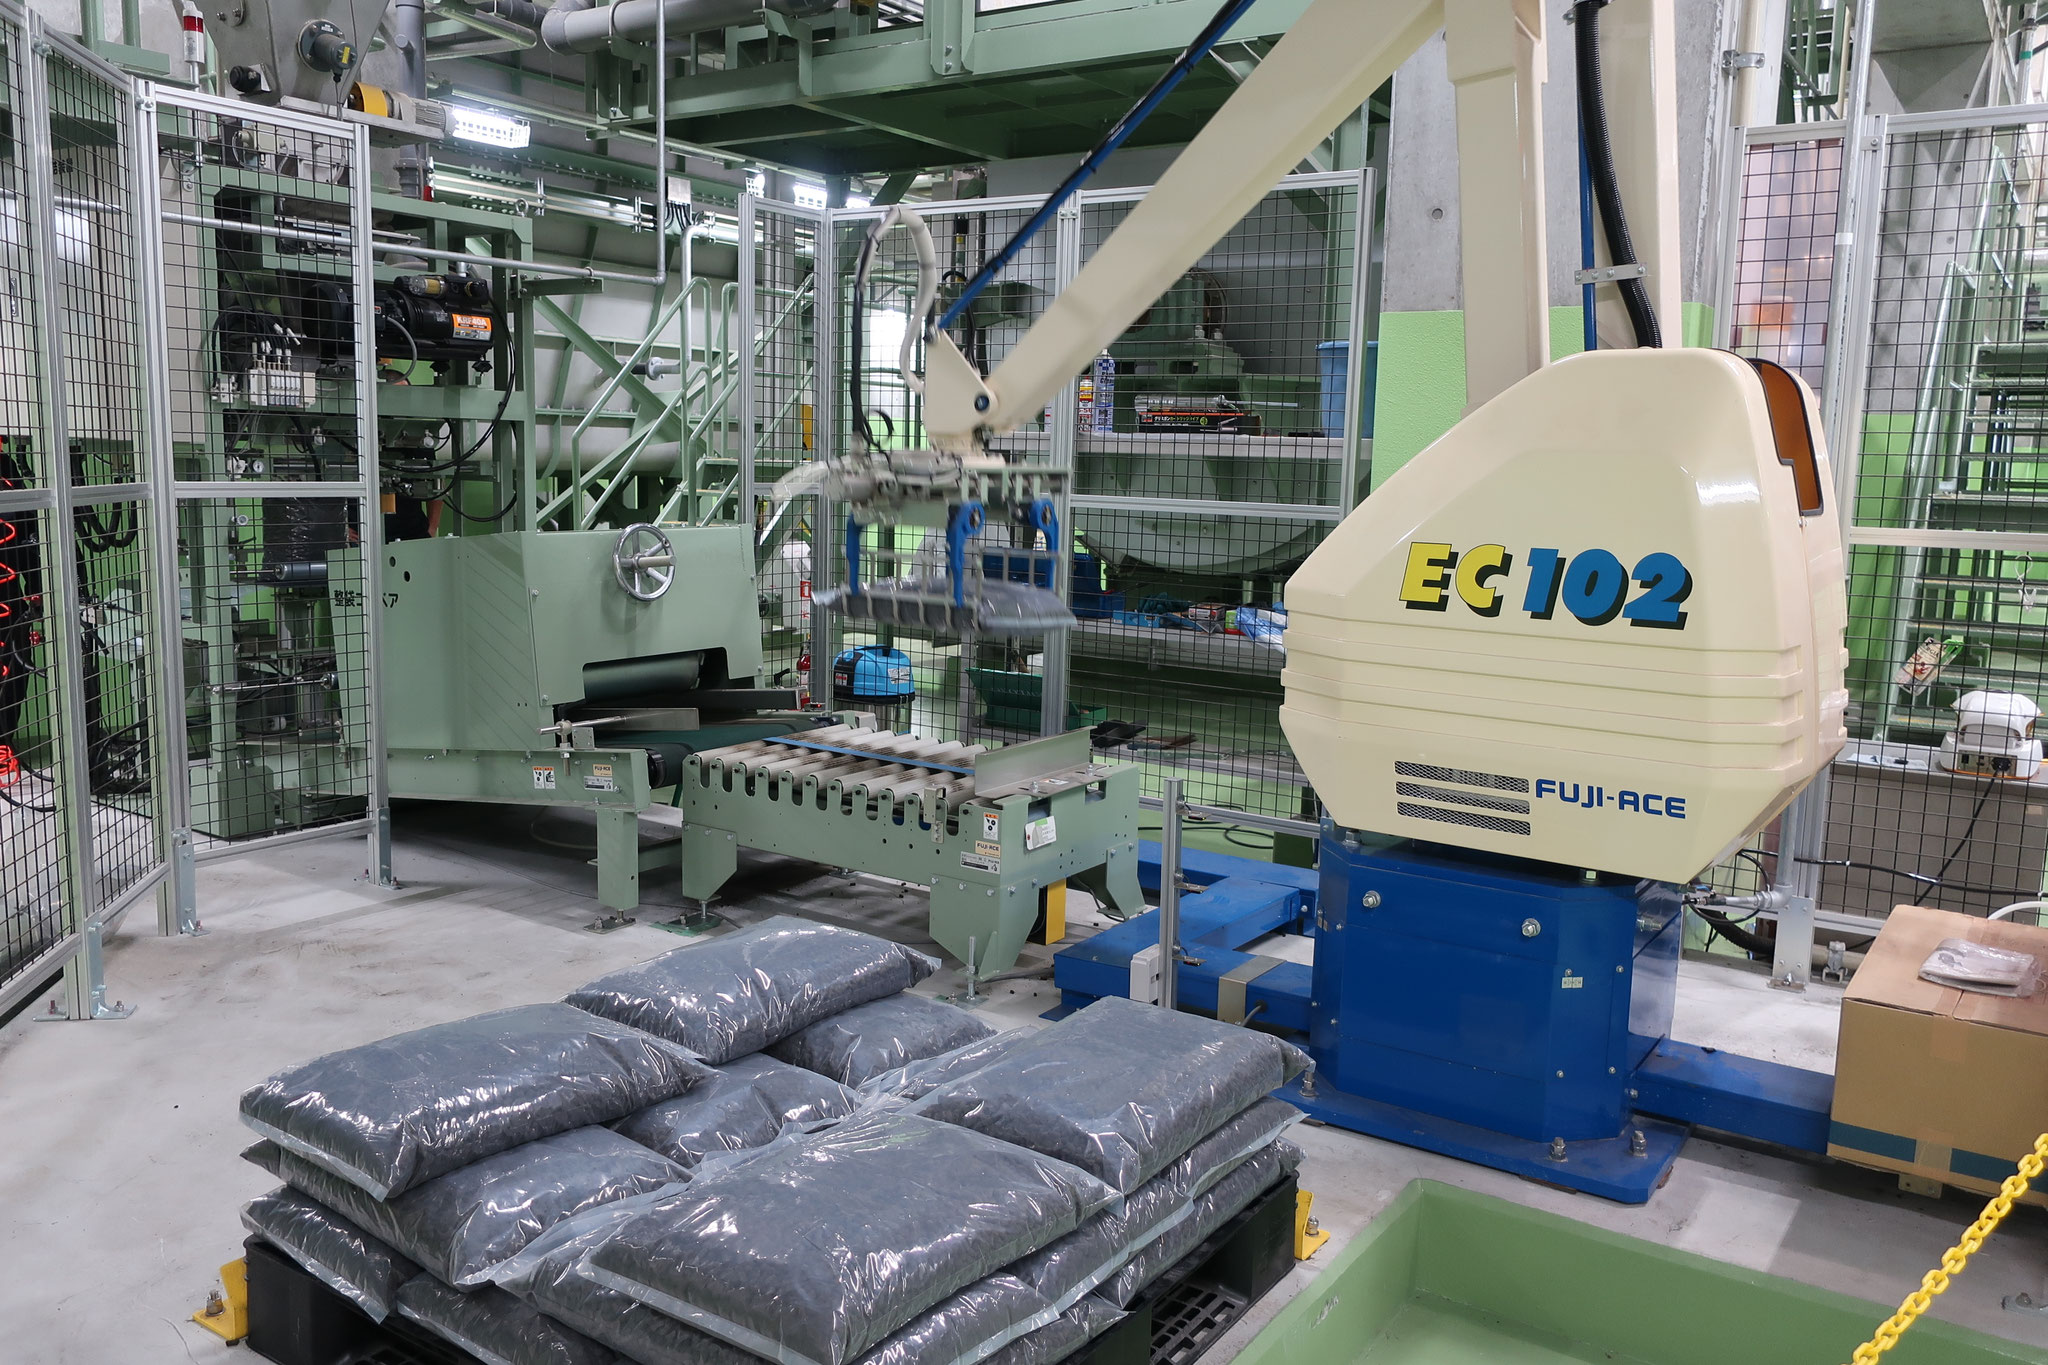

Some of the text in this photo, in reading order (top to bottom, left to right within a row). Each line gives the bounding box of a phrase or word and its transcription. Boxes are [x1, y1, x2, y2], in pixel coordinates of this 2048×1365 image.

[1399, 542, 1692, 630] EC 102
[1535, 778, 1686, 819] FUJI-ACE
